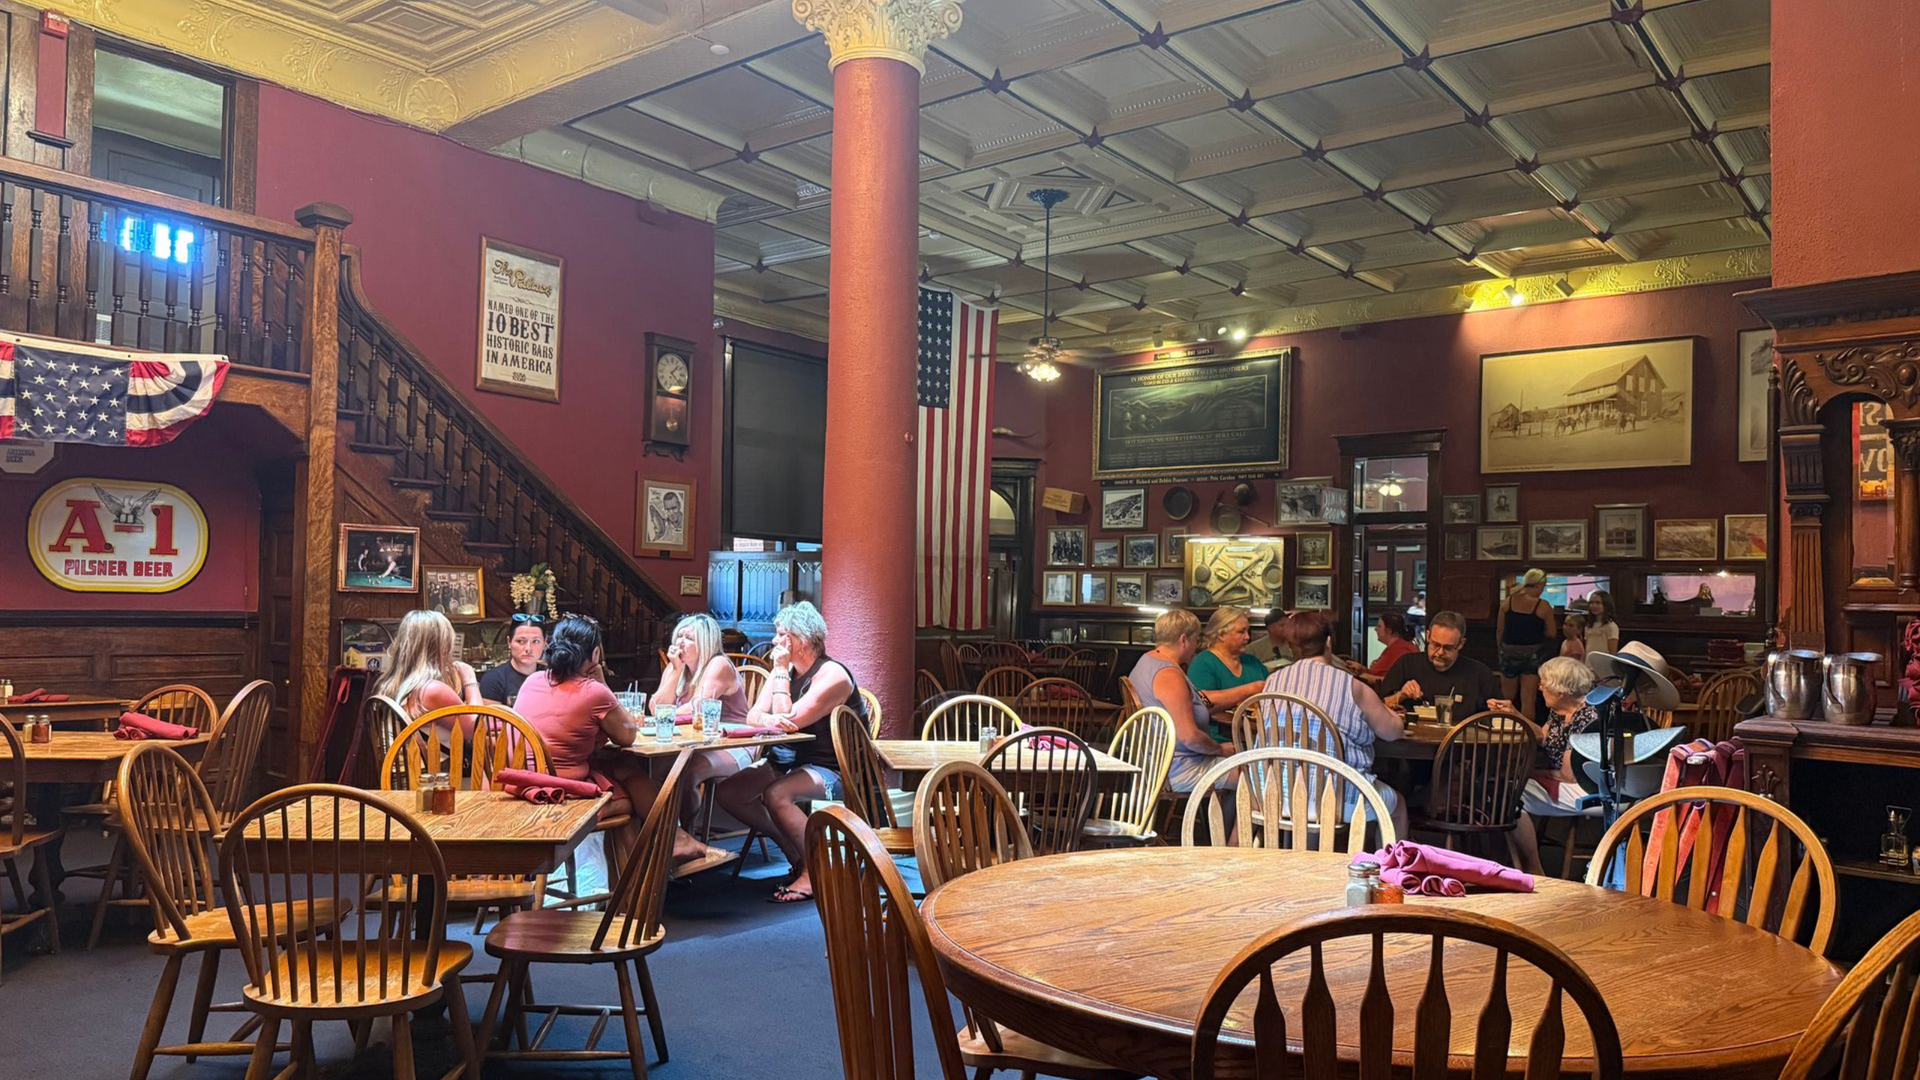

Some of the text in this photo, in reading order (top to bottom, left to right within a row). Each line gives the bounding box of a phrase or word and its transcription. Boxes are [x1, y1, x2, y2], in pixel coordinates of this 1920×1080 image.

[492, 259, 513, 277] The
[509, 268, 552, 298] Palace
[487, 299, 555, 324] NAMED ONE OF THE
[487, 310, 555, 345] 10 BEST
[487, 333, 554, 360] HISTORIC BARS
[486, 349, 552, 375] IN AMERICA
[1136, 374, 1156, 382] HONOR
[1197, 369, 1218, 377] FALLEN
[1218, 366, 1249, 374] BROTHERS
[6, 448, 35, 457] ARIZONA
[1321, 489, 1347, 507] DINING
[1322, 506, 1346, 521] ROOM
[49, 499, 178, 555] A-1
[64, 558, 173, 577] PILSNER BEER
